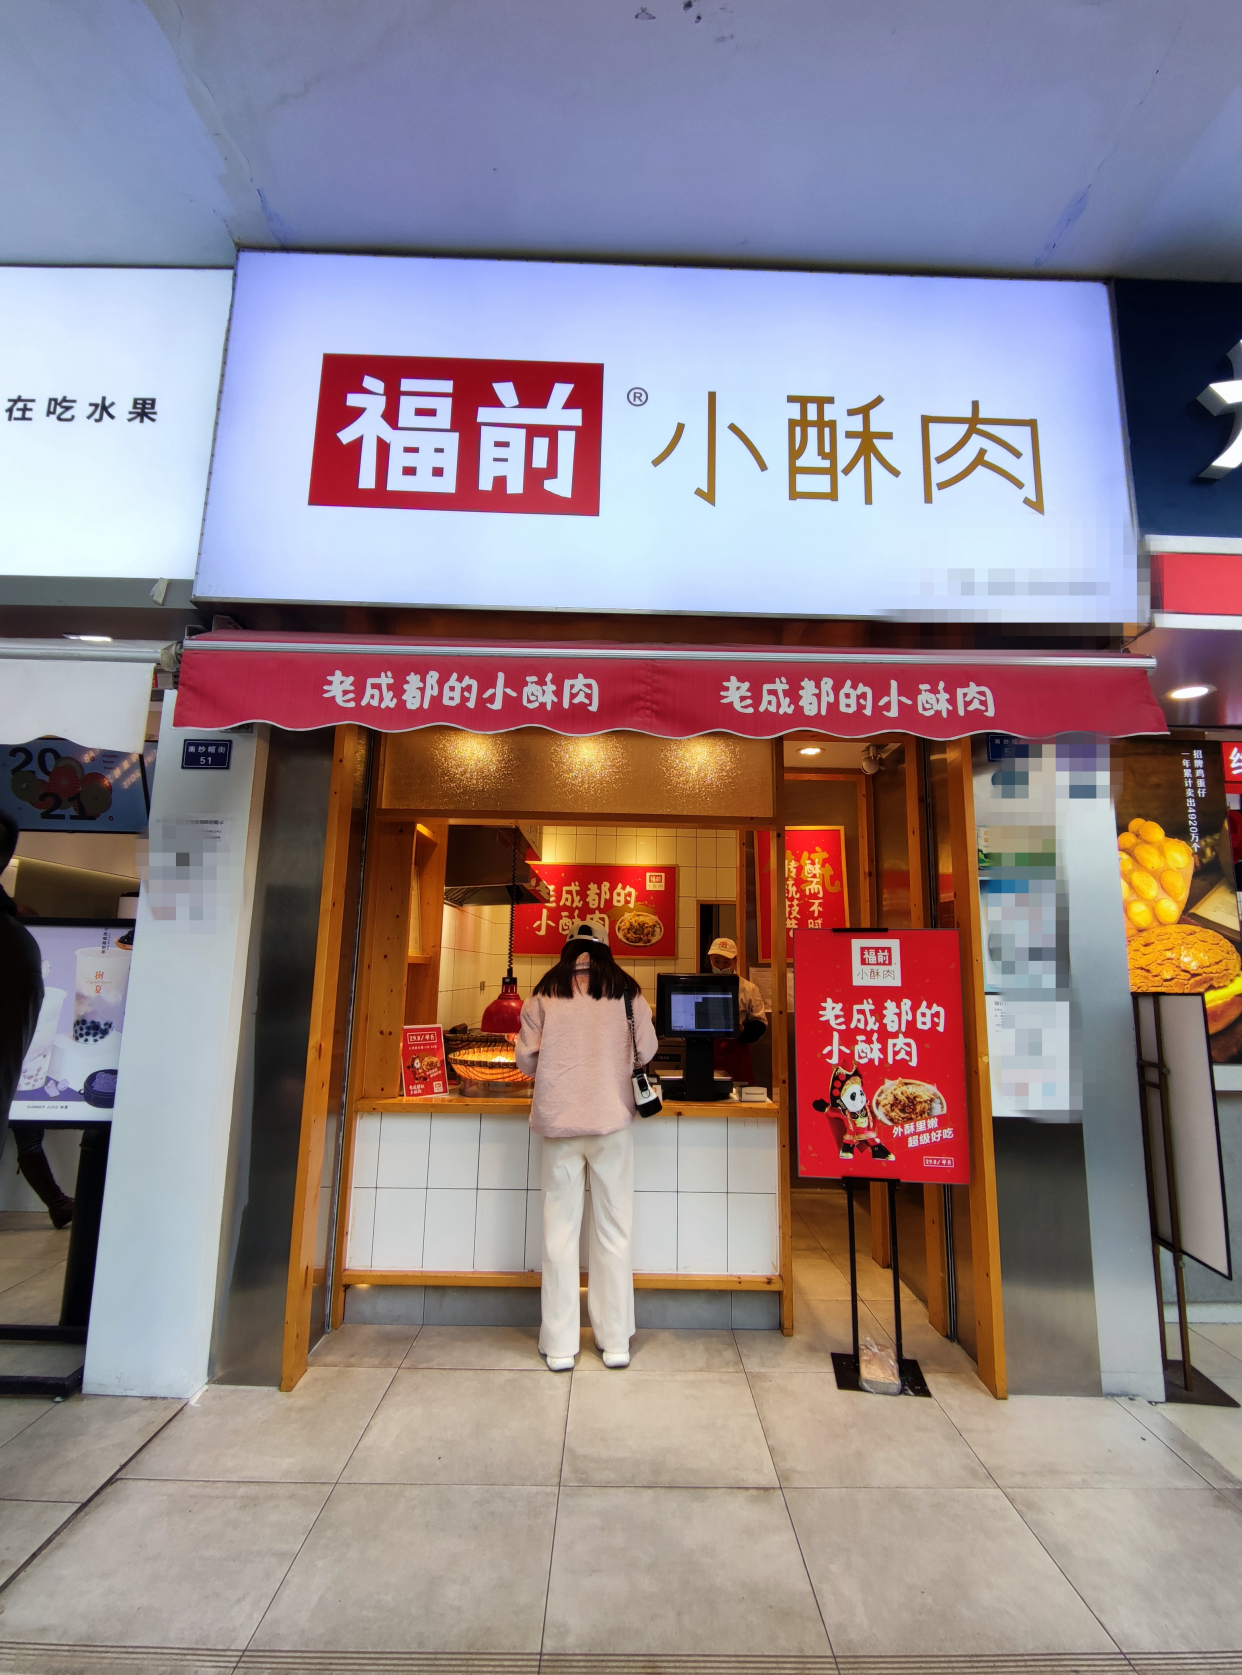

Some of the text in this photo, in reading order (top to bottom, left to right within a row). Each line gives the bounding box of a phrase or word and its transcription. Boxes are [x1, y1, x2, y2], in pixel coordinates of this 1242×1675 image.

[5, 395, 158, 423] 在吃水果
[336, 374, 583, 498] 福前
[651, 390, 1045, 516] 小酥肉
[322, 670, 599, 712] 老成都的小酥肉
[720, 675, 995, 718] 老成都的小酥肉
[1193, 750, 1207, 798] 招牌鸡蛋仔
[1180, 752, 1201, 852] 一年累计卖出4920万个
[857, 968, 896, 980] 小酥肉
[863, 949, 889, 964] 福前
[819, 997, 945, 1032] 老成都的
[822, 1031, 918, 1067] 小酥肉
[892, 1117, 939, 1138] 外酥里嫩
[907, 1127, 954, 1148] 超级好吃
